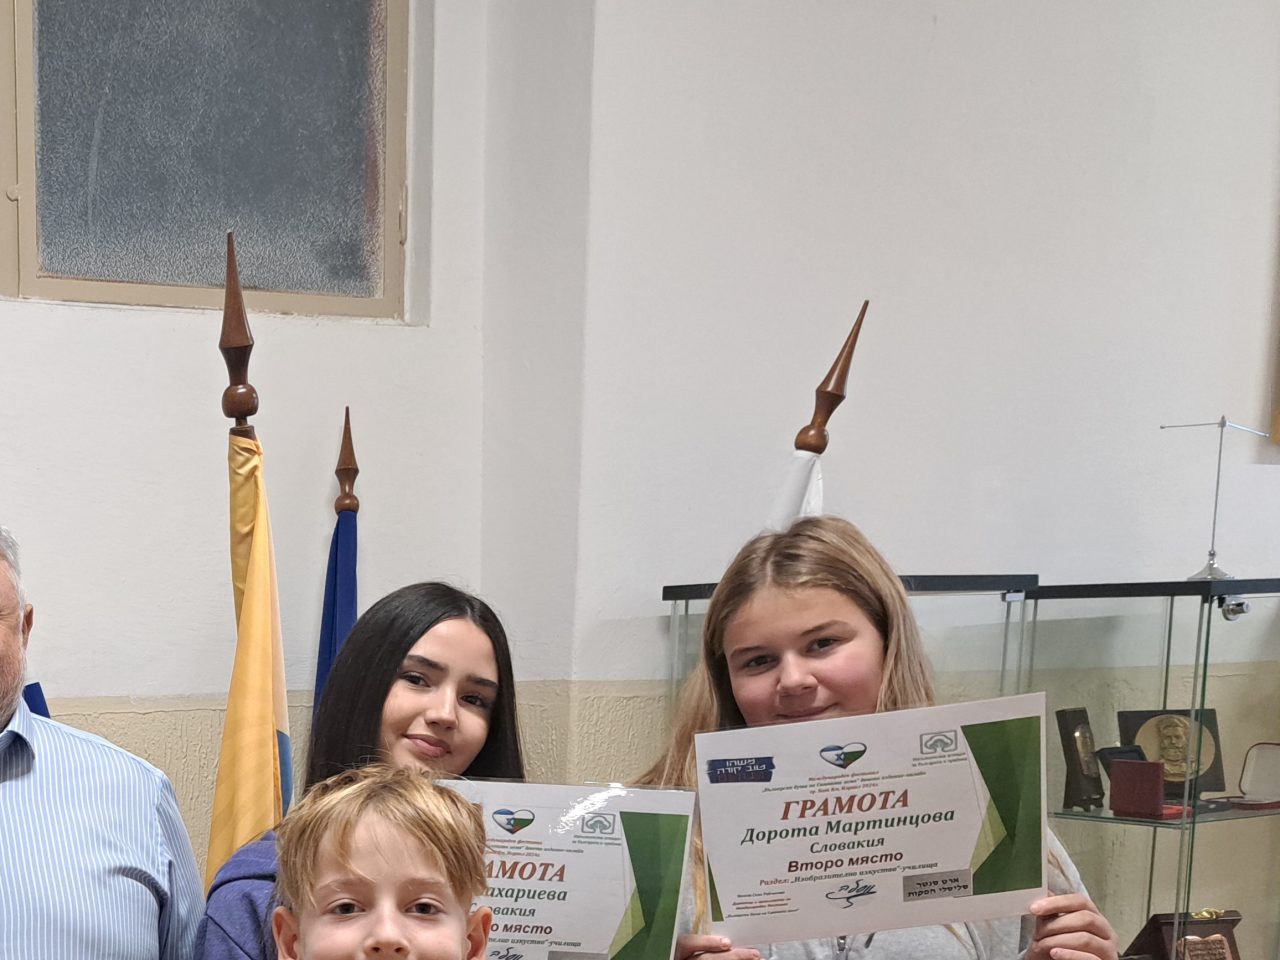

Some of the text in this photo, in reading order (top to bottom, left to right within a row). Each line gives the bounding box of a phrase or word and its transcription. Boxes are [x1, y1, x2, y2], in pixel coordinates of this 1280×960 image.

[780, 789, 909, 821] ГРАМОТА
[740, 810, 955, 846] Дорота Мартинцова
[810, 837, 885, 854] Словакия
[485, 860, 566, 882] АМОТА
[787, 851, 904, 873] Второ място
[759, 877, 790, 886] Раздел:
[487, 886, 568, 903] ахариева
[502, 923, 553, 935] място
